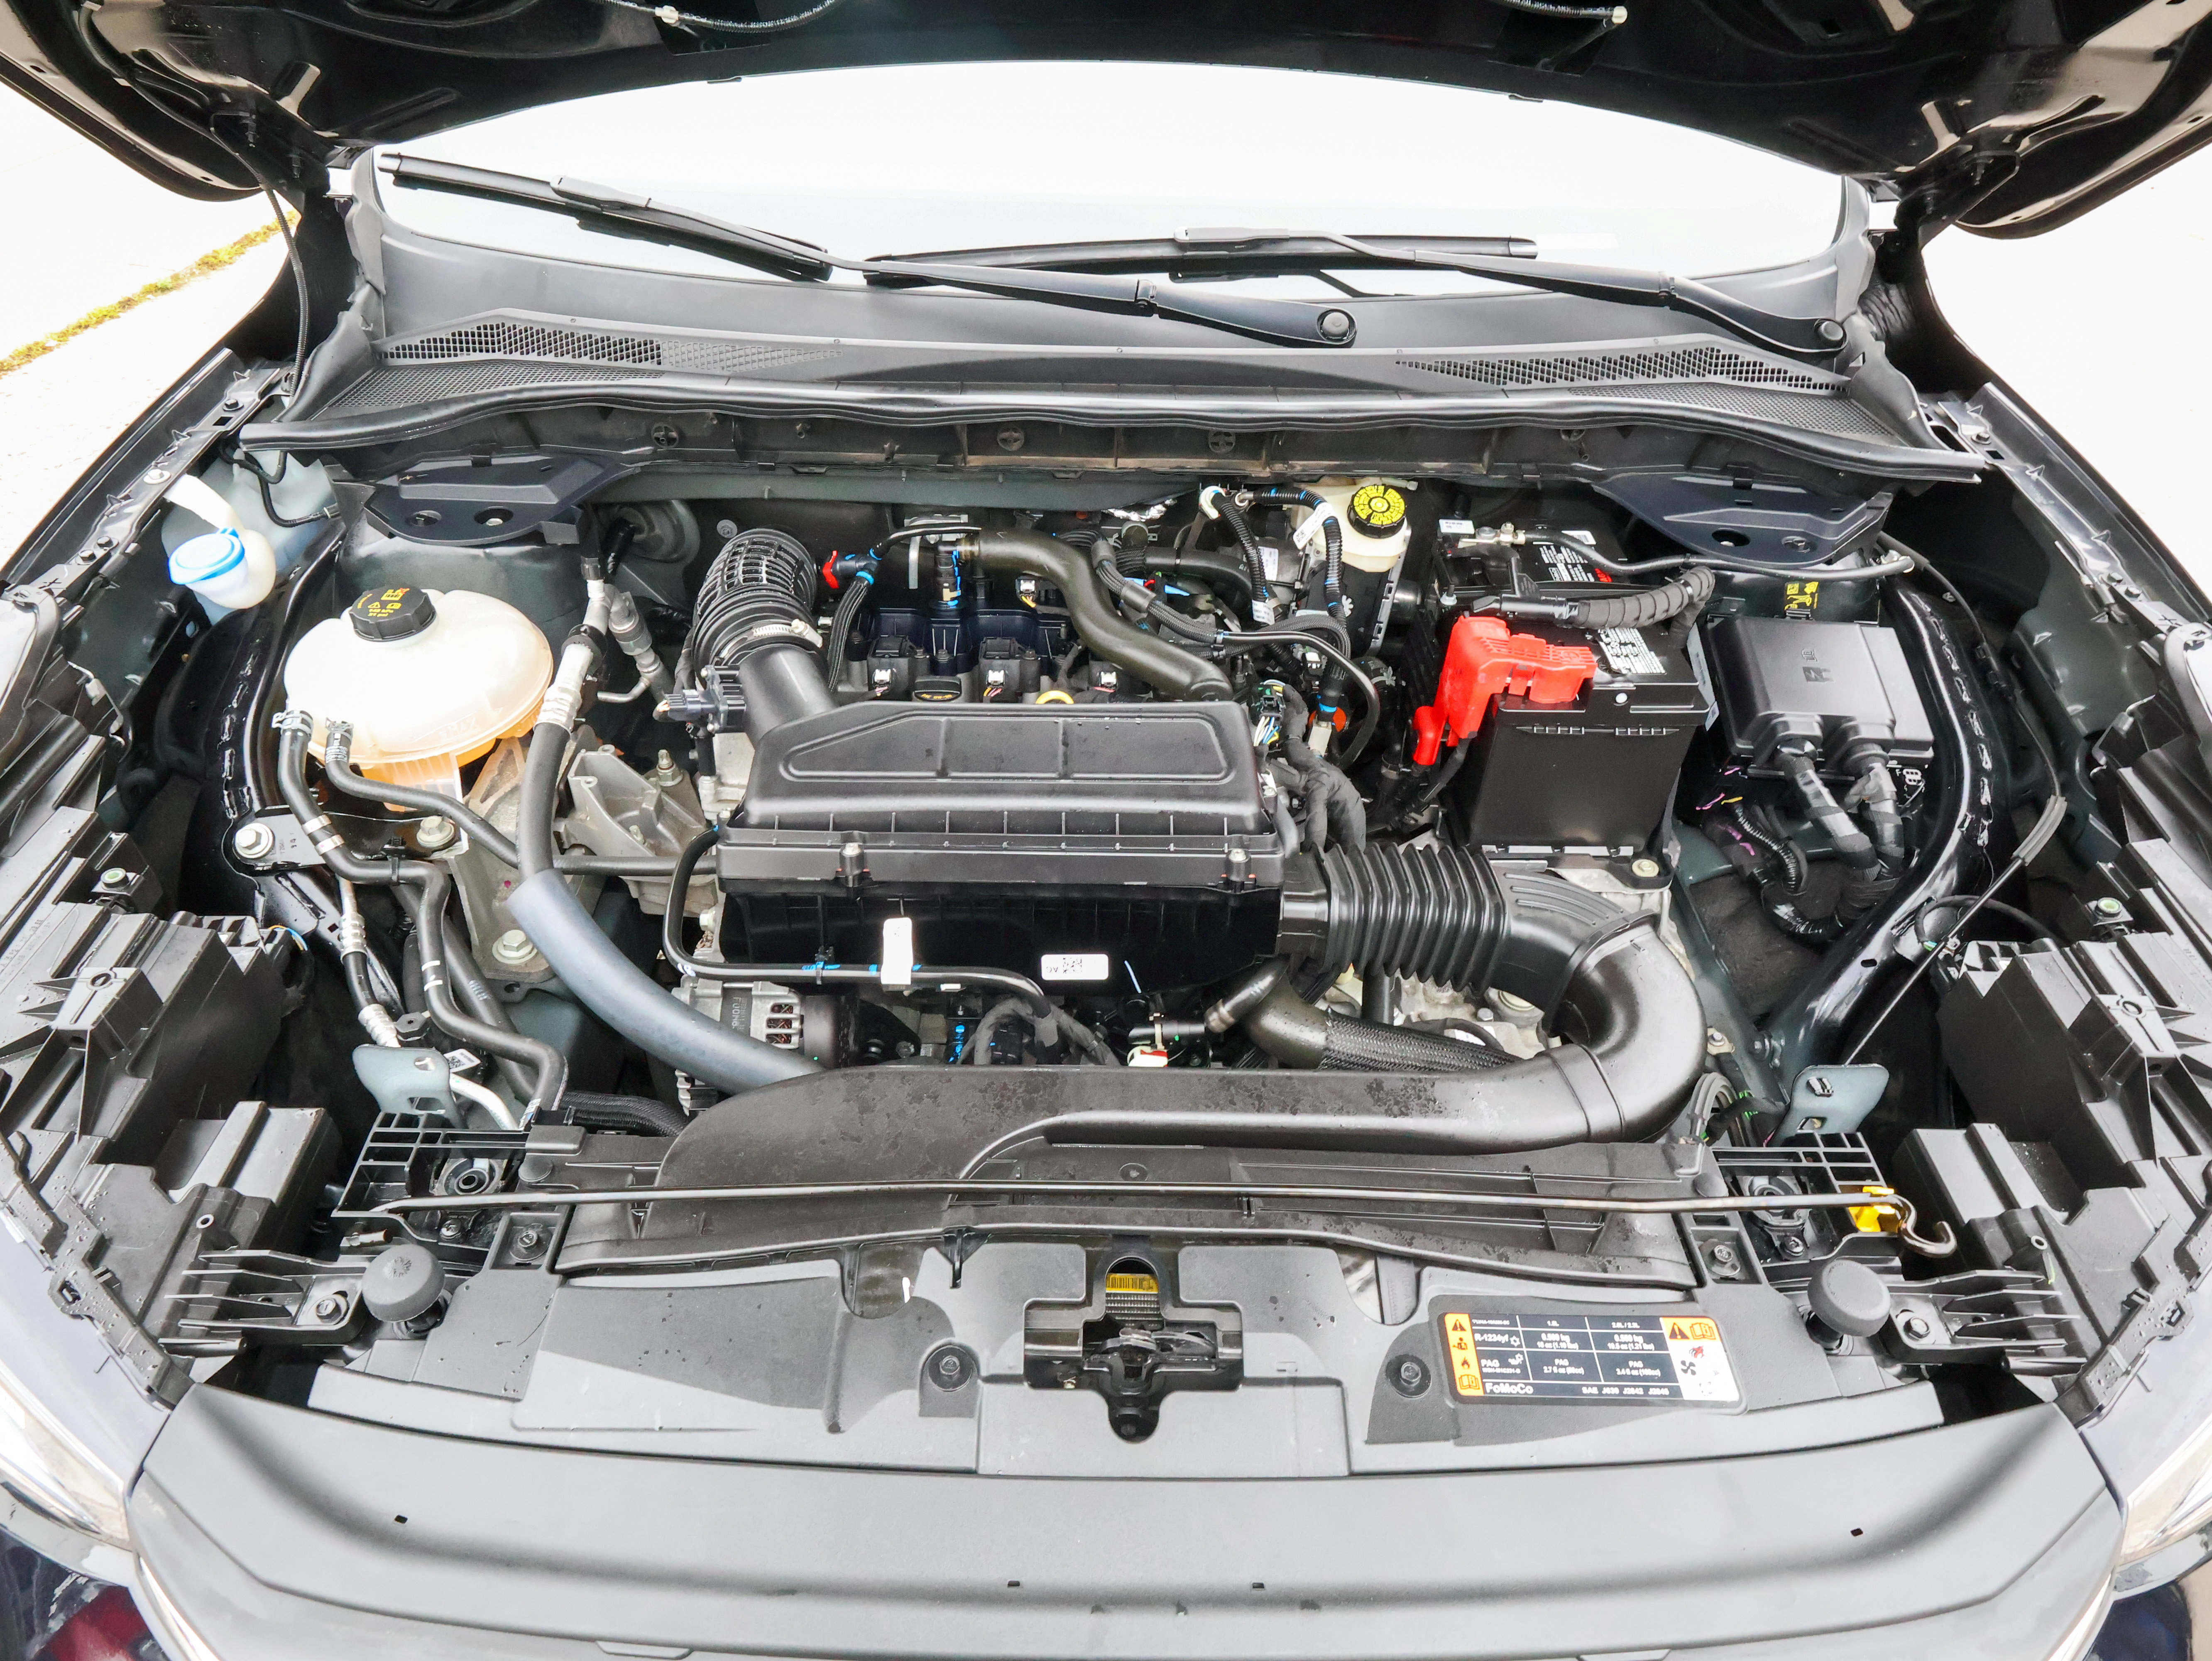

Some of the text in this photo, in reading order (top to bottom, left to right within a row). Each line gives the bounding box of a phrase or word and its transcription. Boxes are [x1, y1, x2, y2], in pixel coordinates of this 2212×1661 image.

[1474, 1333, 1509, 1343] R-1234yf
[1560, 1334, 1570, 1343] kg
[1633, 1335, 1643, 1343] kg
[1480, 1359, 1500, 1367] PAG
[1485, 1382, 1534, 1394] FoMoCo
